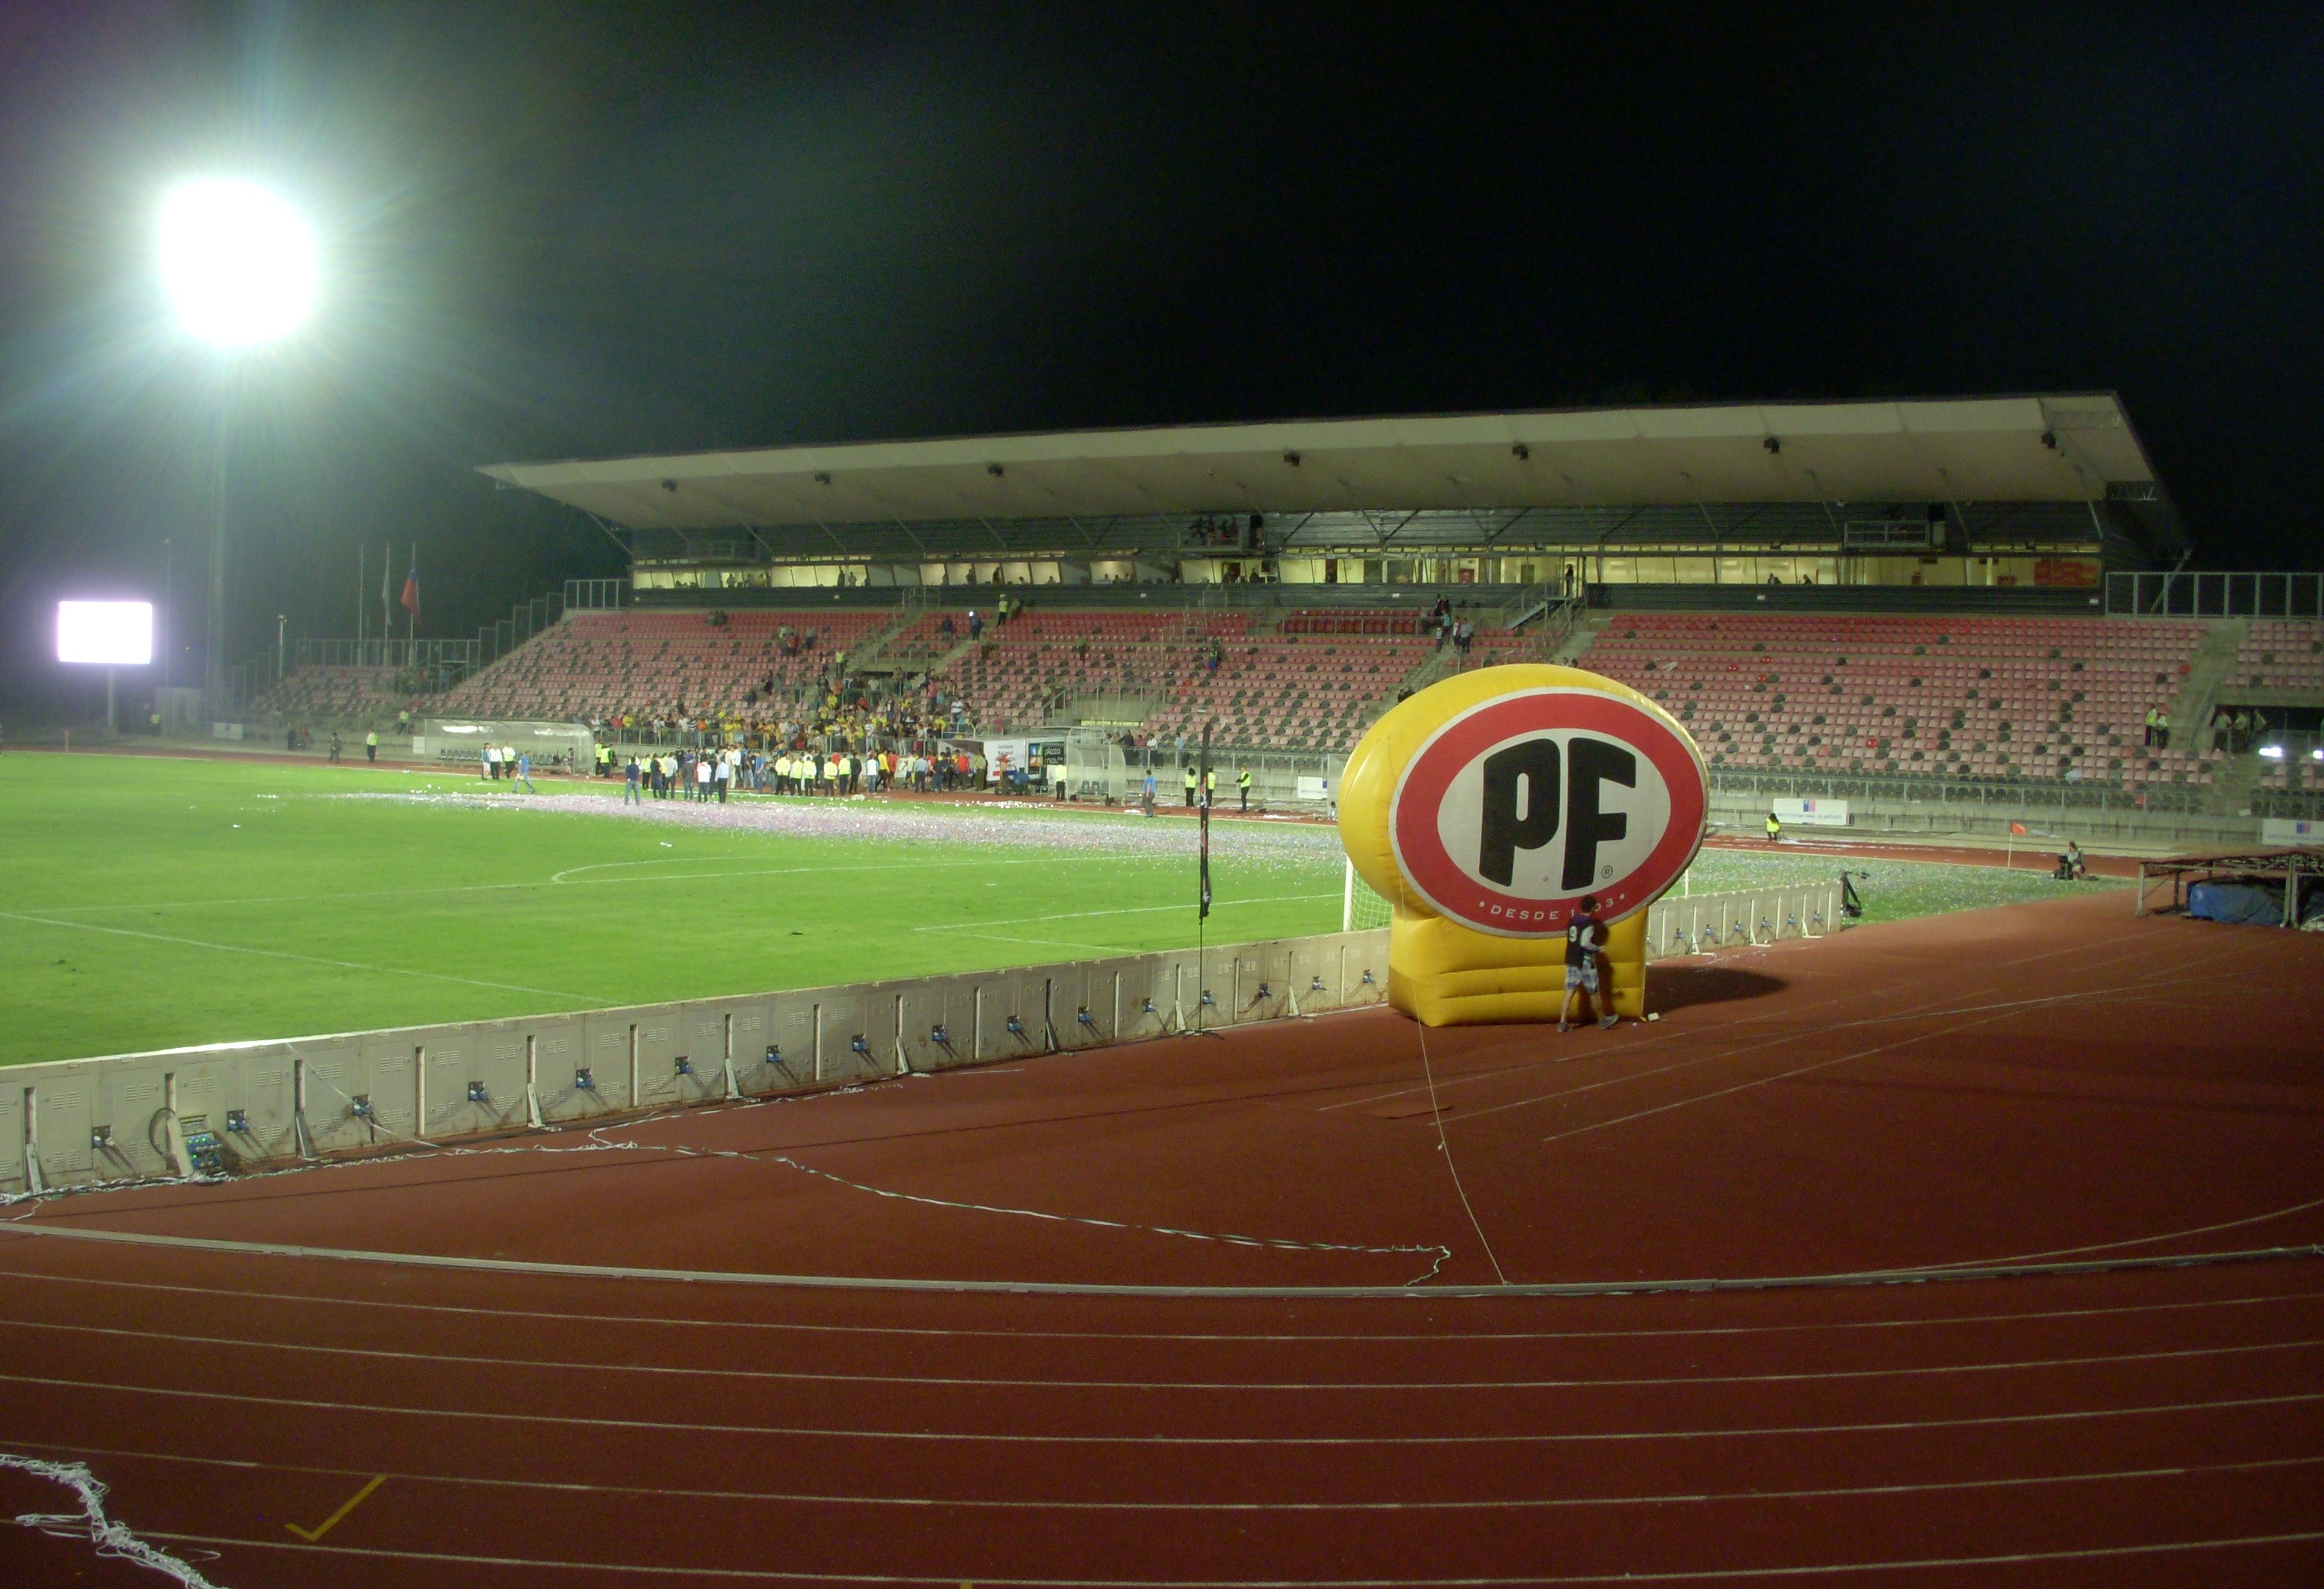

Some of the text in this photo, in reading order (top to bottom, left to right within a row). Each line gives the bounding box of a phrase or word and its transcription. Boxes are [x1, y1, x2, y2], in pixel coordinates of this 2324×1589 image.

[1479, 737, 1636, 891] PF
[1490, 897, 1614, 920] DESDE 103
